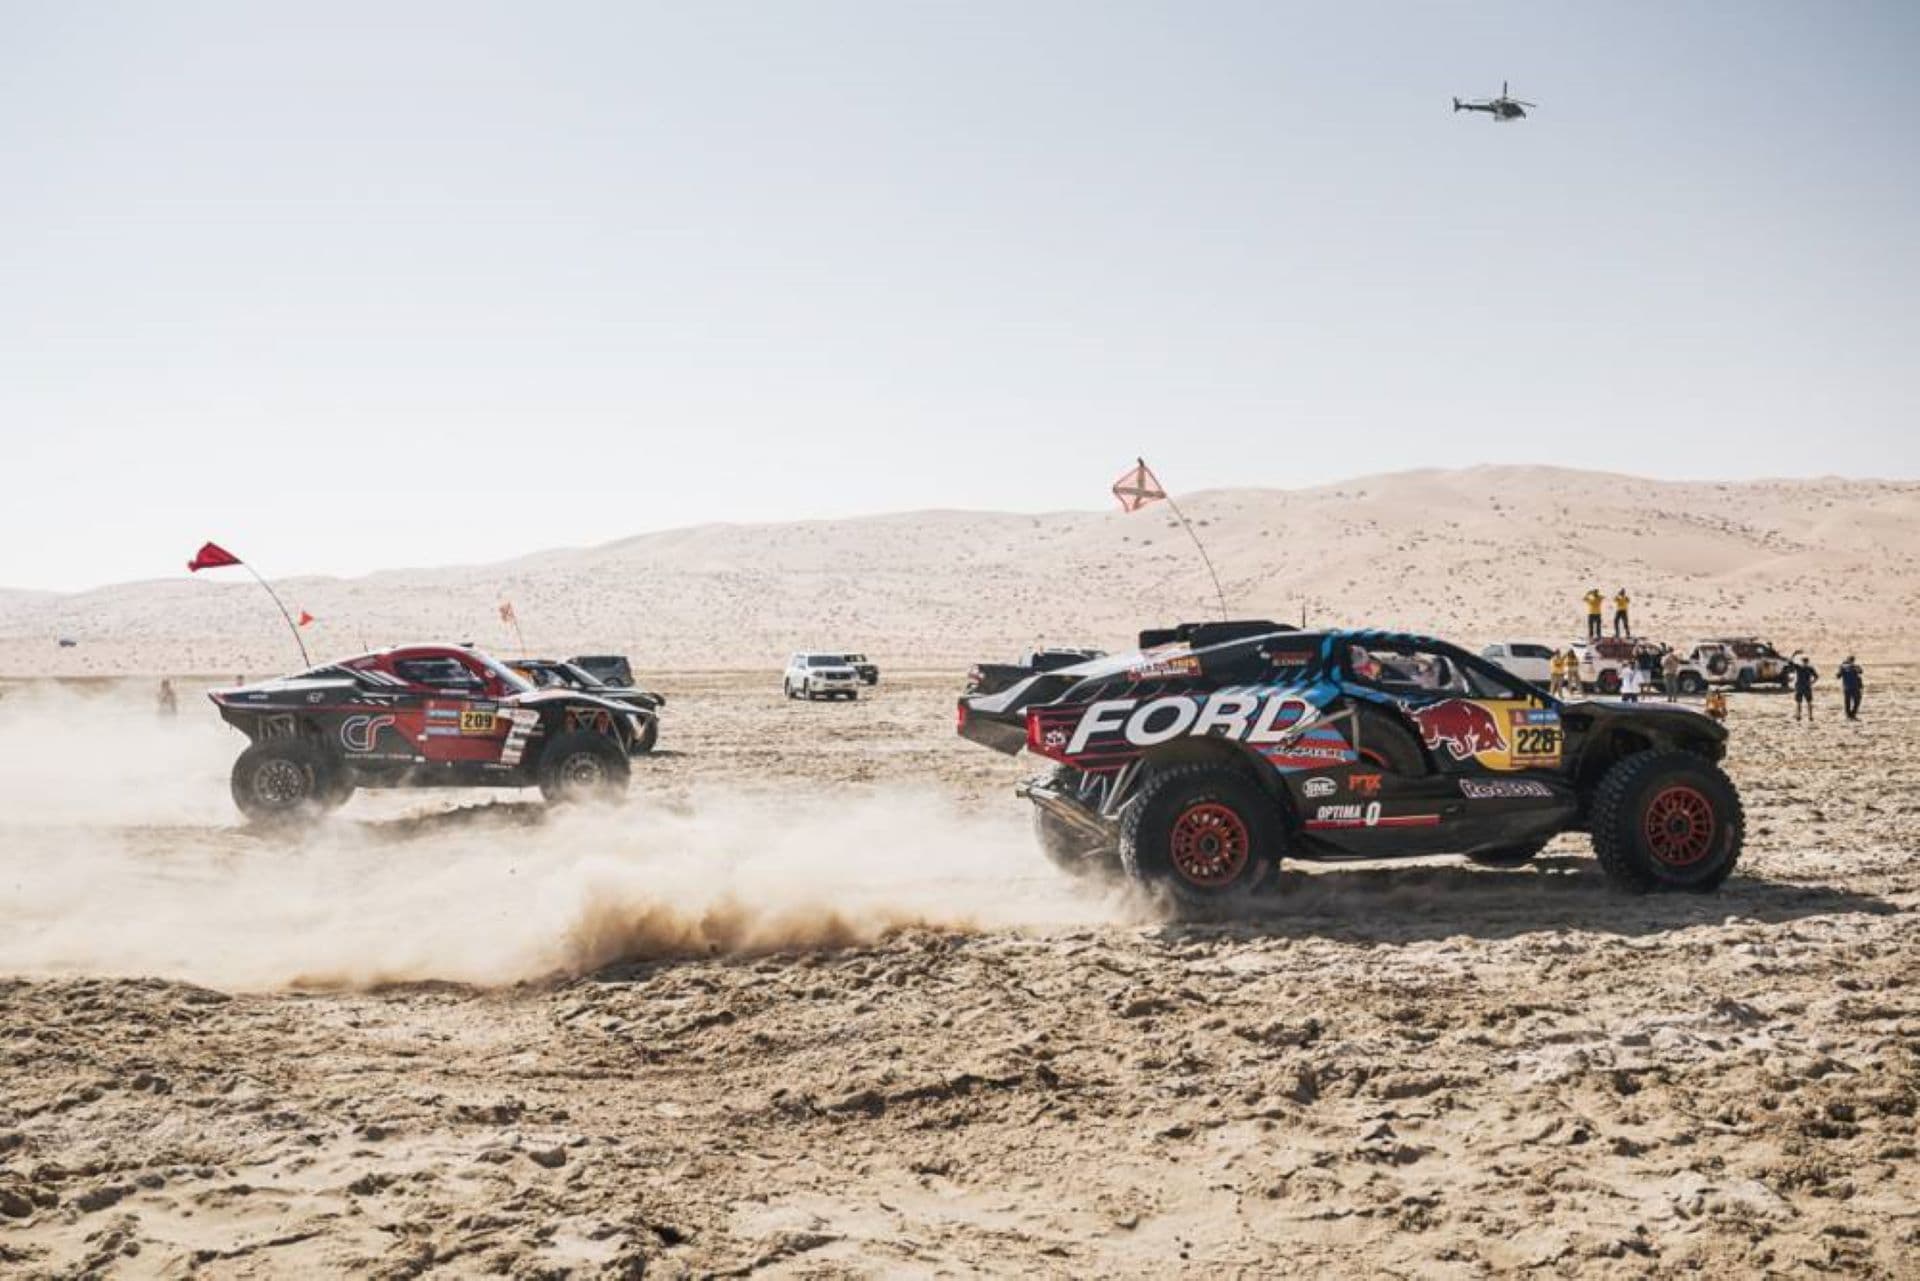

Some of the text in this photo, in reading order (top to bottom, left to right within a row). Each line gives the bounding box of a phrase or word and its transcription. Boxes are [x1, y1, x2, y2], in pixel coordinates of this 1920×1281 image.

[465, 713, 492, 728] 209
[1066, 694, 1320, 754] FORD
[1518, 728, 1556, 754] 228
[1317, 805, 1362, 820] OPTIMA
